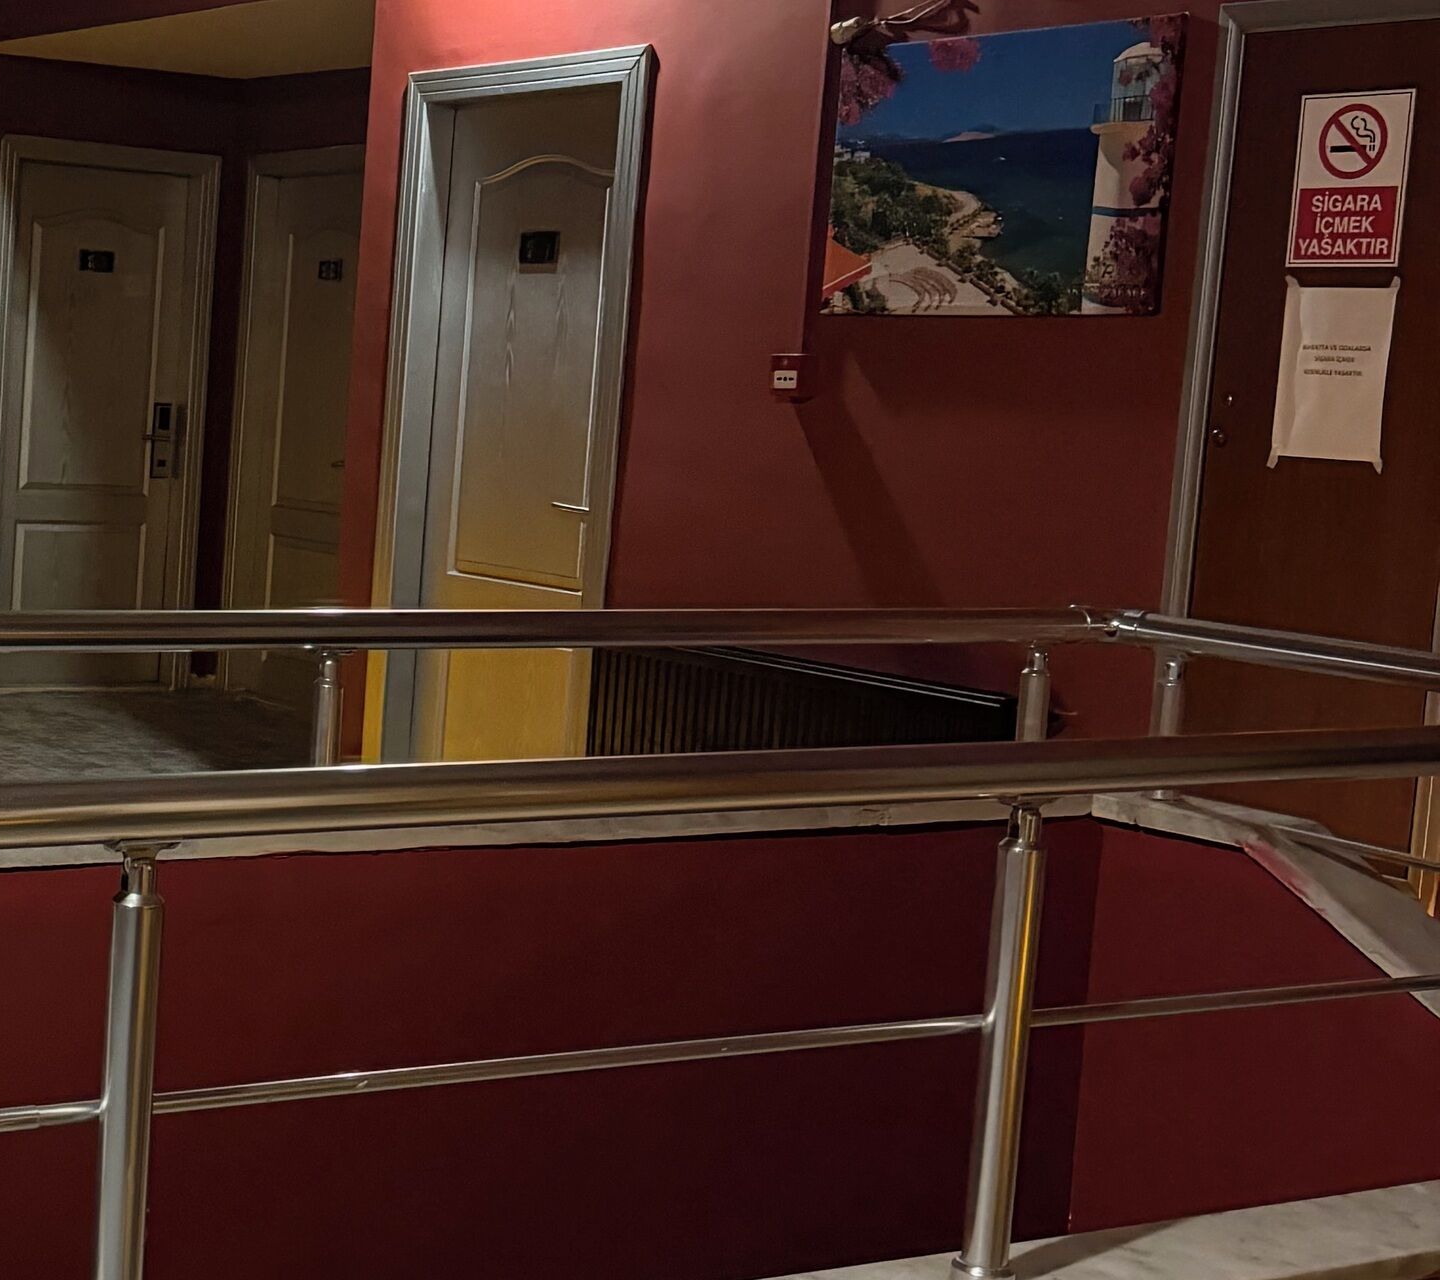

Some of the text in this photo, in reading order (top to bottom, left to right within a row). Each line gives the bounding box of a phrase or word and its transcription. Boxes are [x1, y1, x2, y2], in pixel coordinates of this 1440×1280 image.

[1311, 191, 1383, 213] SİGARA
[1315, 213, 1375, 238] İÇMEK
[1298, 238, 1389, 255] YASAKTIR
